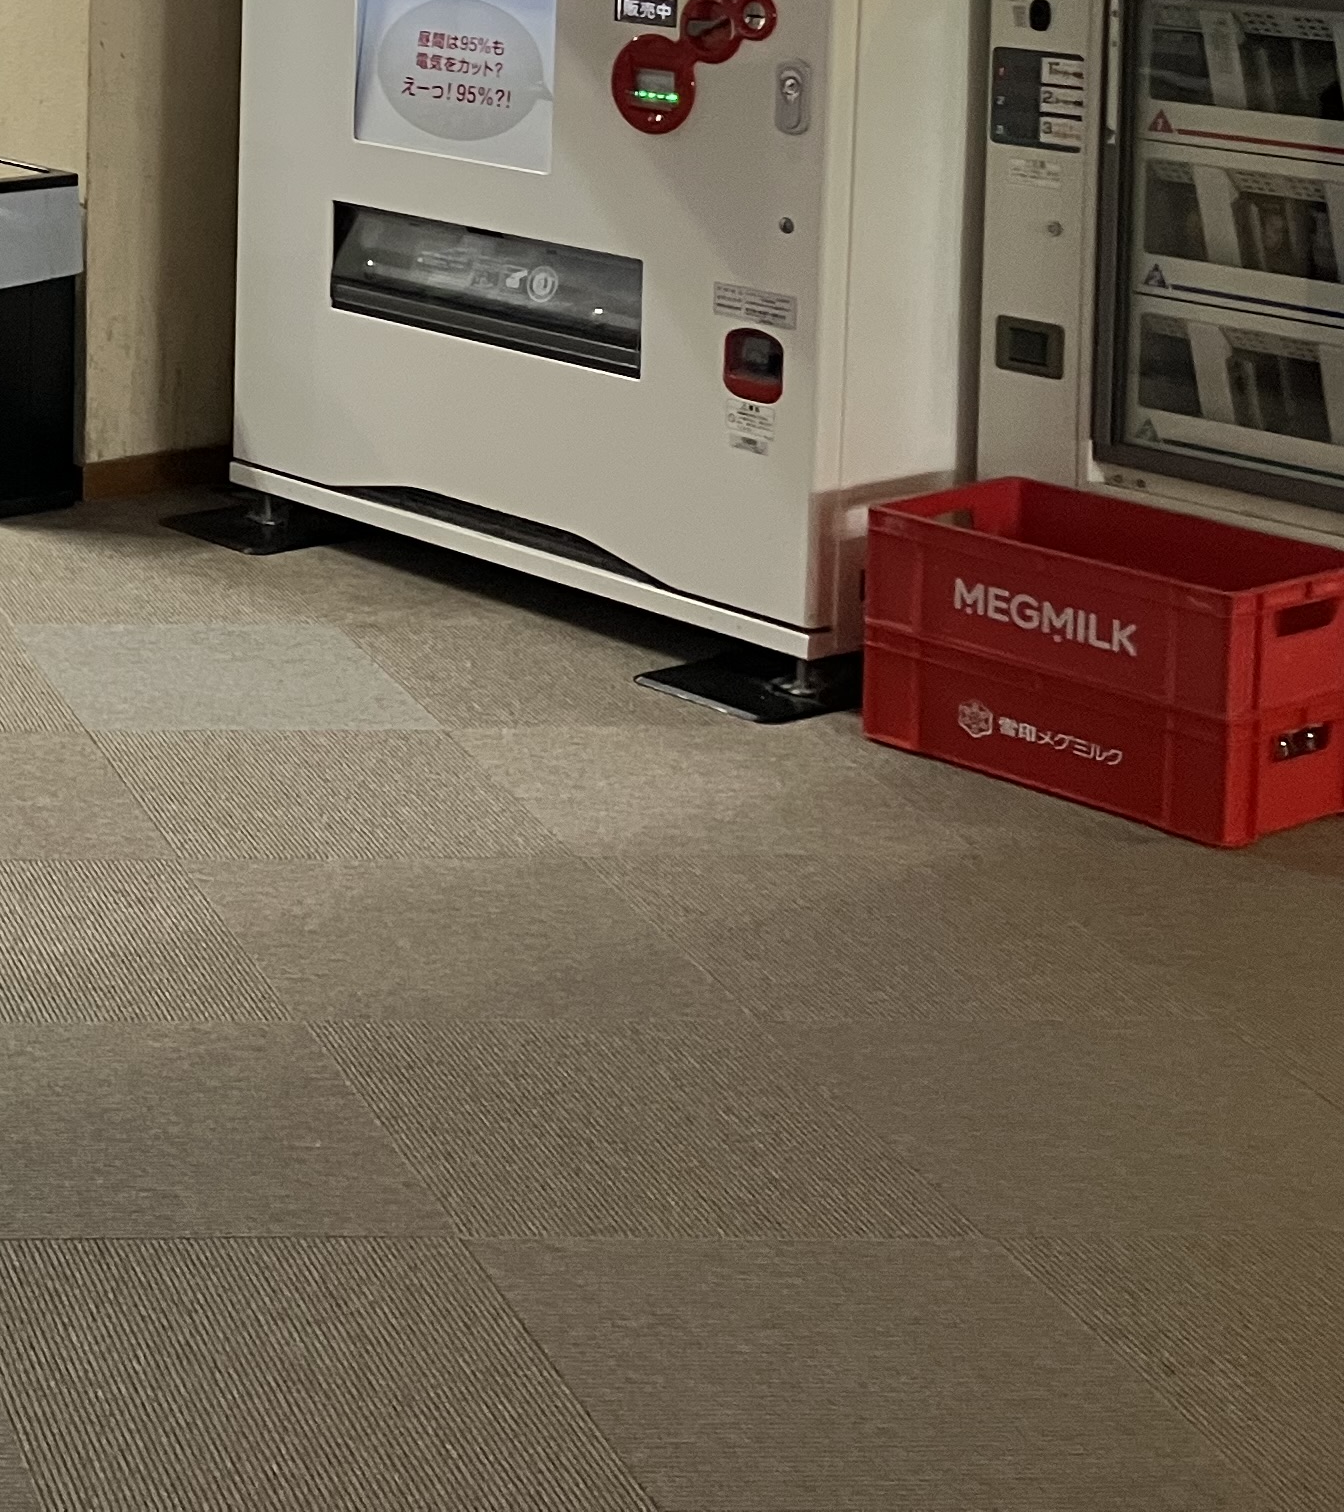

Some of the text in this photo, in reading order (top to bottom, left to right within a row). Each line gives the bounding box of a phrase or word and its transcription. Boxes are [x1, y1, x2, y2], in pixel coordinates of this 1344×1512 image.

[416, 29, 506, 57] 昼間は95%も
[415, 52, 505, 80] 電気をカット?
[1041, 121, 1053, 136] 3
[952, 577, 1137, 657] MEGMILK
[998, 715, 1124, 766] 雪印メグミルク
